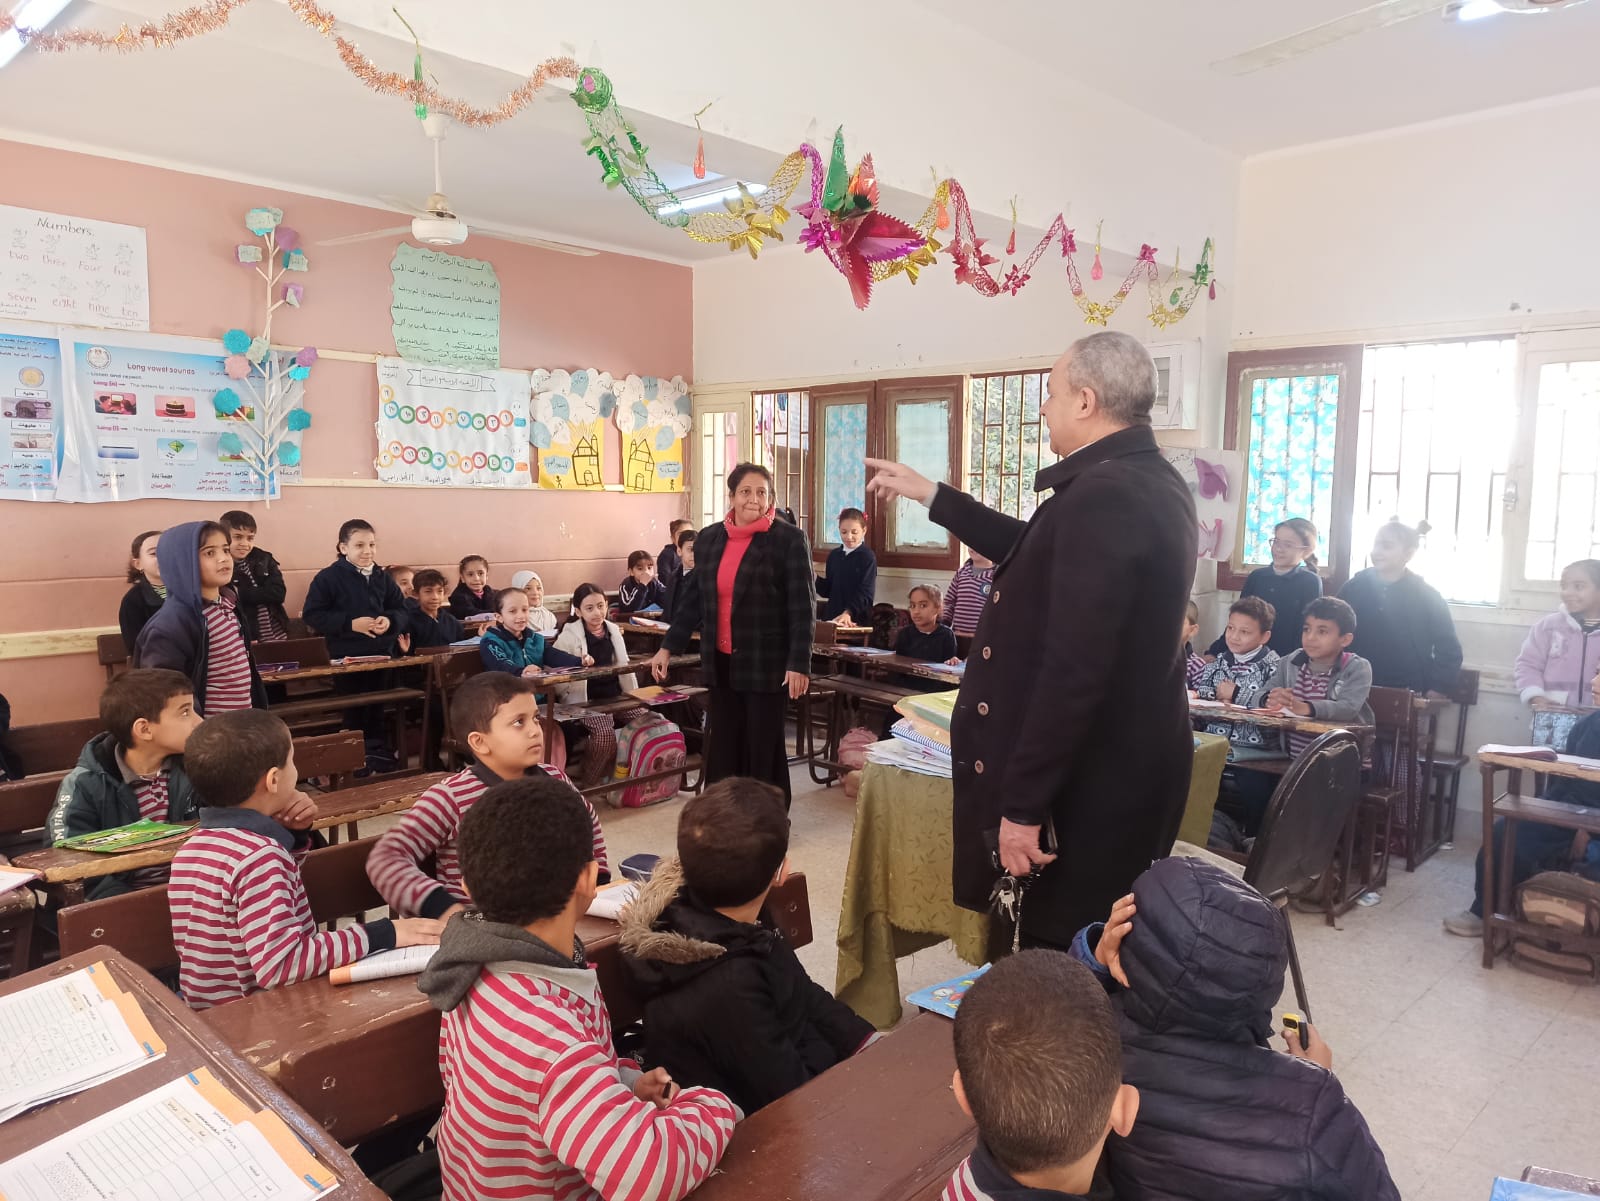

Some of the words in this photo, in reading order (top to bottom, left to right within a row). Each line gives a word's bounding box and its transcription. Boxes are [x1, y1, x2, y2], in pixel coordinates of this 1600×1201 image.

[9, 250, 29, 261] two
[52, 298, 77, 309] eight
[122, 306, 139, 317] ten
[127, 363, 146, 372] Long
[147, 365, 168, 373] vowel
[169, 367, 196, 375] sounds
